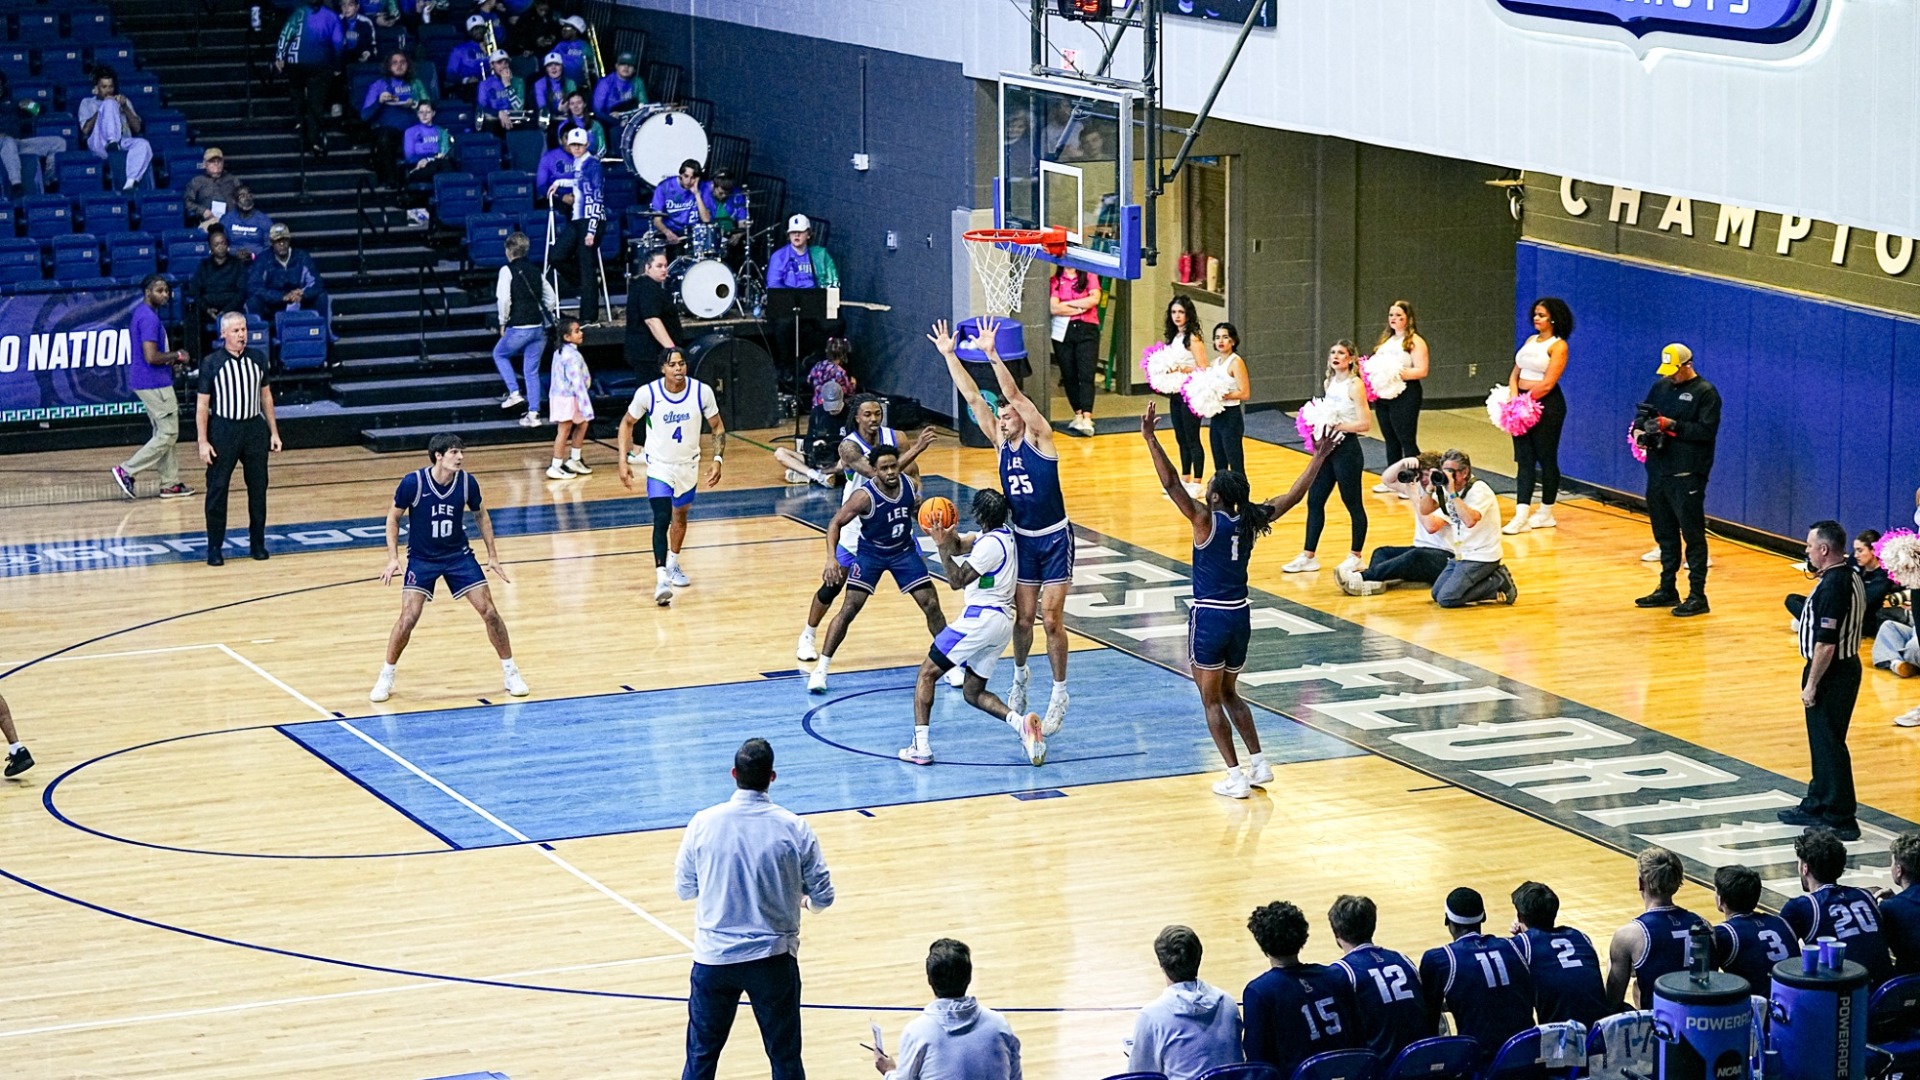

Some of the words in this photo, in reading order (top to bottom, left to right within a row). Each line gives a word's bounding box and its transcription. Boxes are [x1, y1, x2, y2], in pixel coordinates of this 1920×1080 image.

[1559, 175, 1914, 276] CHAMPIO
[672, 426, 683, 443] 4
[1008, 474, 1034, 496] 25
[431, 503, 455, 517] LEE
[887, 506, 909, 523] LEE
[431, 519, 453, 538] 10
[0, 524, 408, 569] @GoArgo
[1230, 535, 1240, 561] 1
[1828, 899, 1878, 939] 20
[1550, 938, 1583, 969] 2
[1671, 929, 1691, 968] 7
[1757, 929, 1789, 962] 3
[1368, 964, 1414, 1004] 12
[1474, 950, 1510, 988] 11
[1301, 996, 1342, 1041] 15
[1837, 996, 1850, 1078] POWERADE
[1716, 1064, 1743, 1078] NCAA
